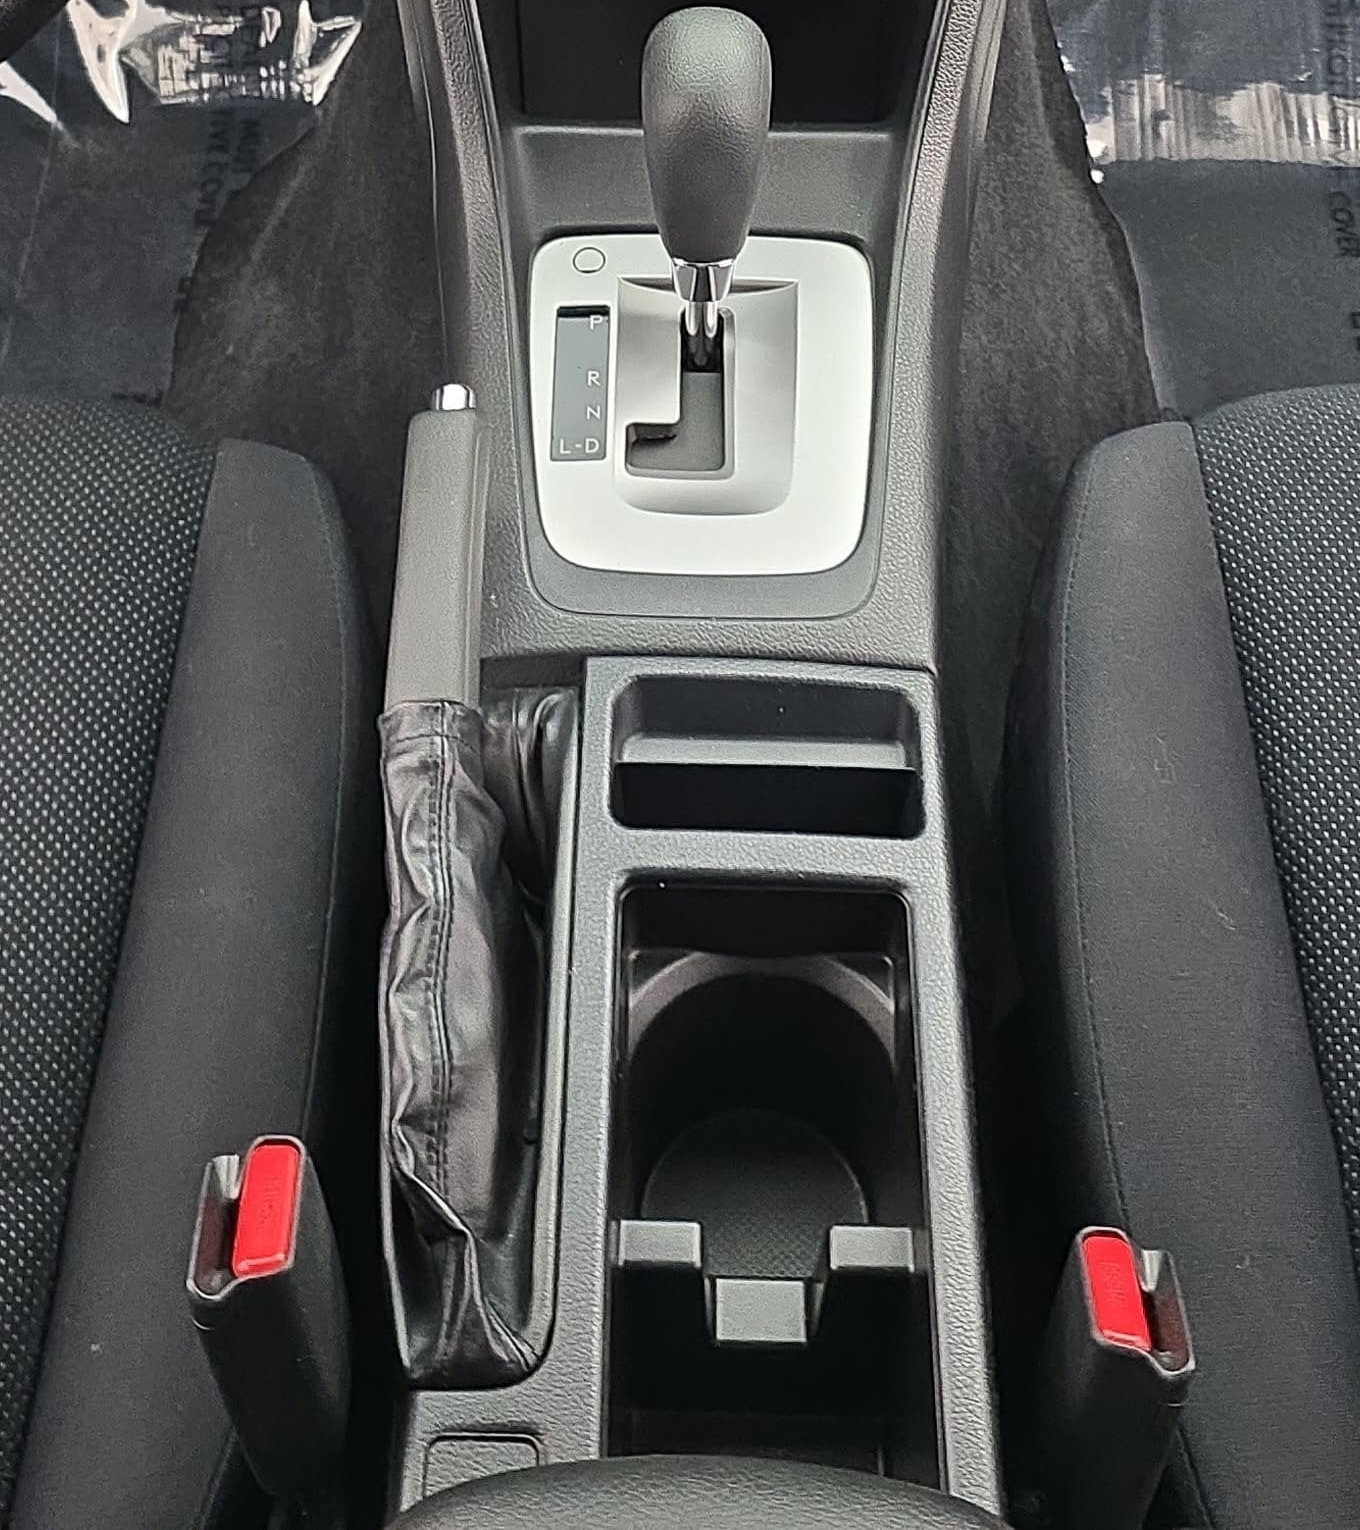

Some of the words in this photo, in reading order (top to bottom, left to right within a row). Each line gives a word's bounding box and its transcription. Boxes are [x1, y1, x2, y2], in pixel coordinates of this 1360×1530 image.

[589, 315, 603, 330] P
[587, 370, 601, 386] R
[586, 405, 601, 420] N
